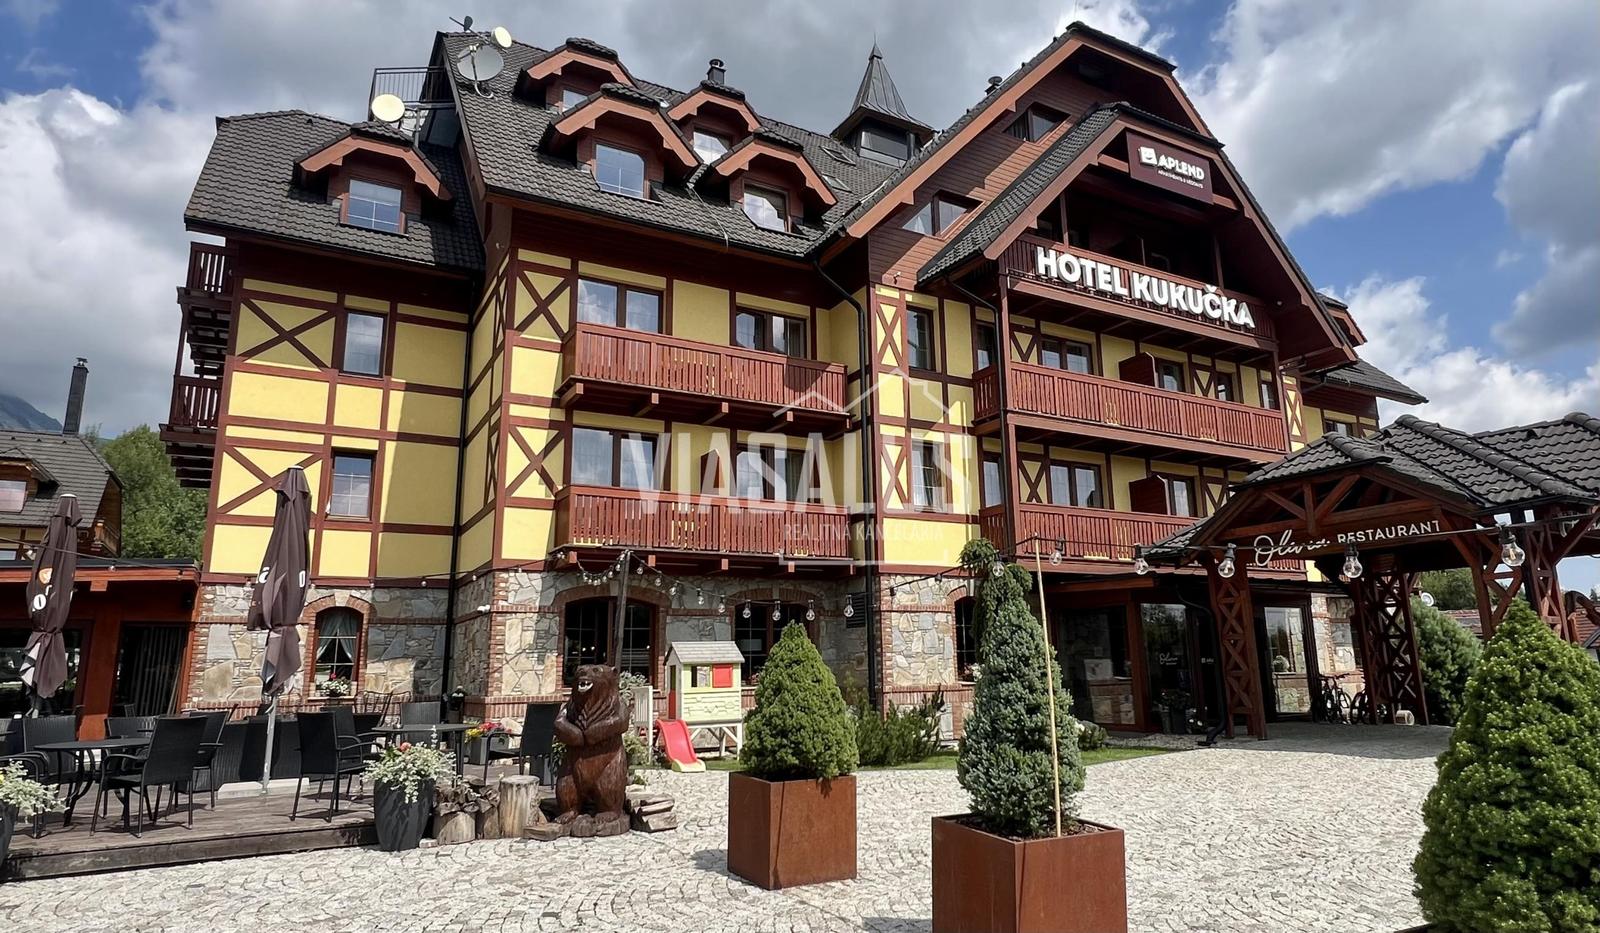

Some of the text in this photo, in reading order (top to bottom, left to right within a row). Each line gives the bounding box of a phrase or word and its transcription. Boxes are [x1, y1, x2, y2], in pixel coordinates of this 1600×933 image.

[1158, 154, 1205, 180] APLEND
[1036, 246, 1256, 328] HOTEL KUKUČKA
[1337, 520, 1441, 544] RESTAURANT
